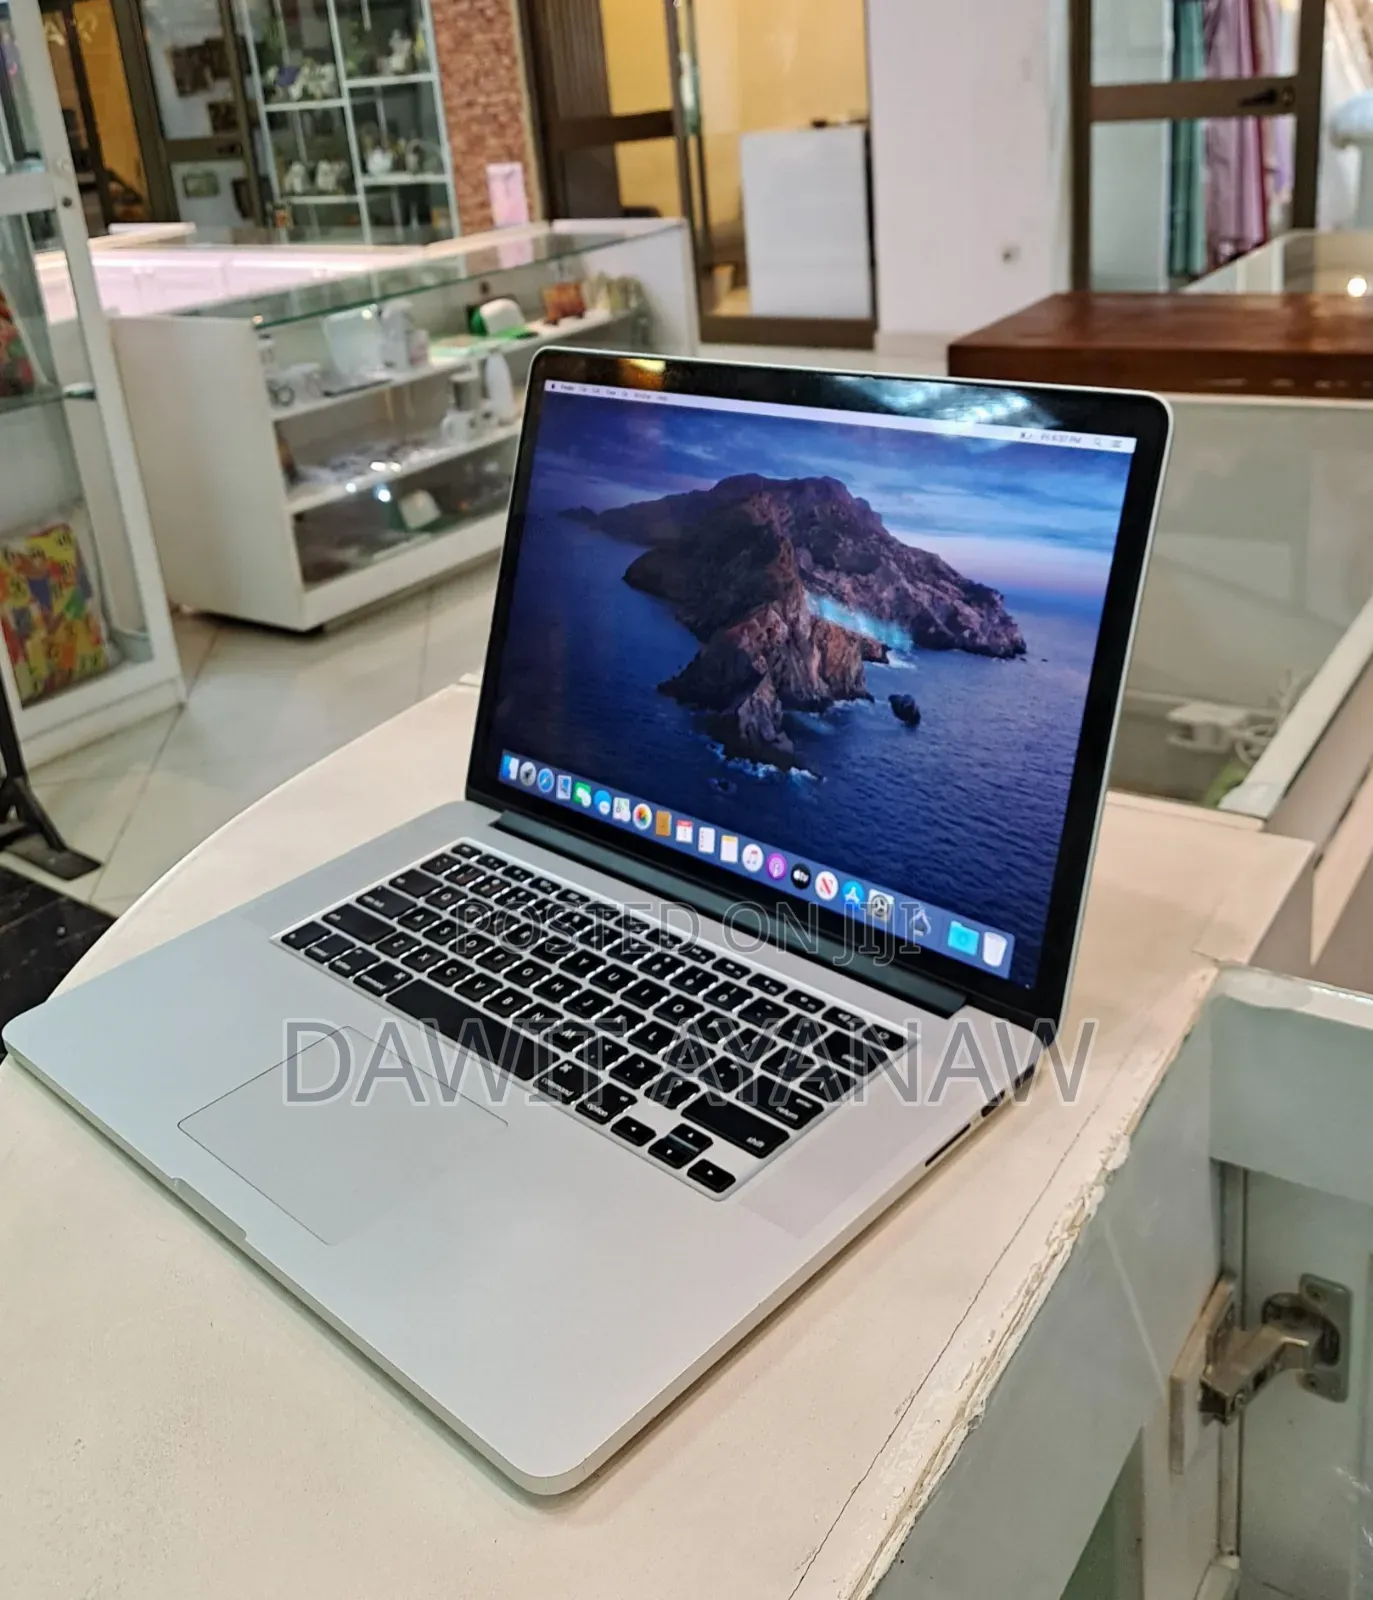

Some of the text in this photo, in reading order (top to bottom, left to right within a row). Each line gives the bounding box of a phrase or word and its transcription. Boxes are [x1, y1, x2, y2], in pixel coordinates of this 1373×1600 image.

[445, 967, 457, 976] C
[608, 972, 620, 980] U
[673, 1004, 685, 1013] O
